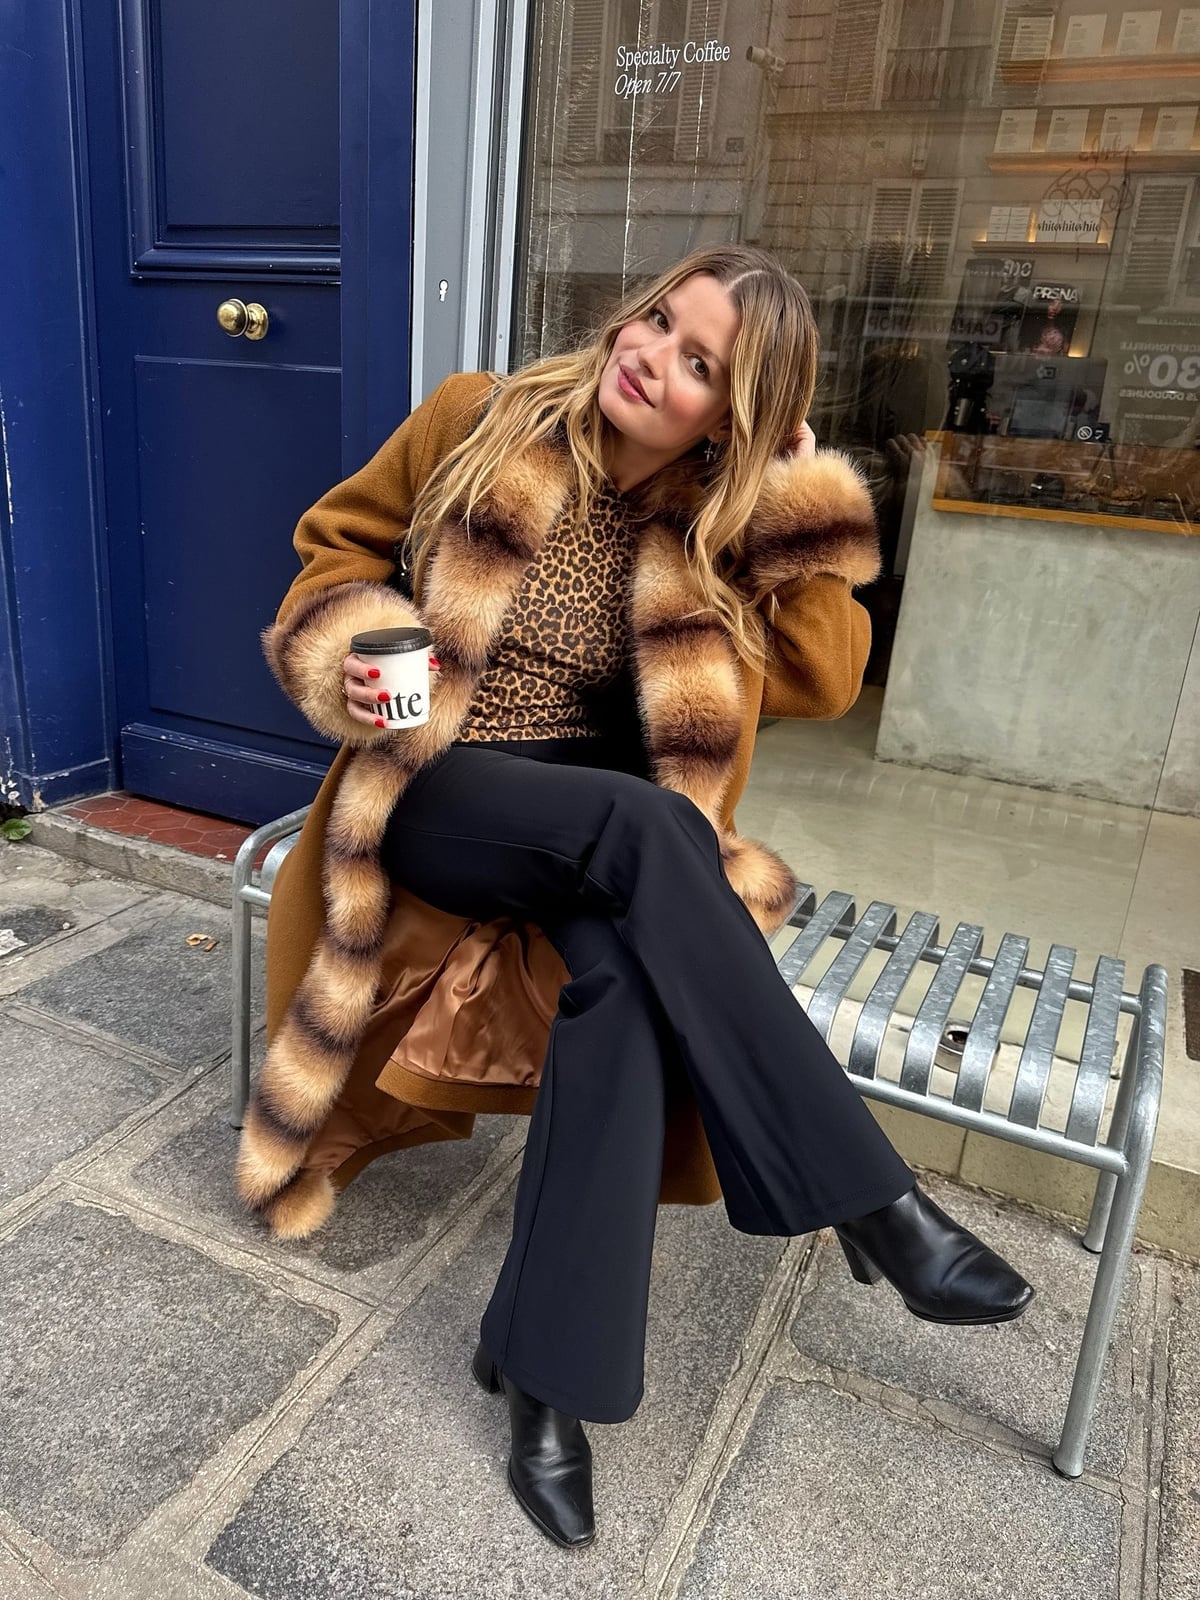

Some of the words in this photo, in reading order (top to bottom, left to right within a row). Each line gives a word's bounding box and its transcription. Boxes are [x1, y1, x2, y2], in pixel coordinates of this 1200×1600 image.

[616, 43, 680, 71] Specialty
[683, 39, 730, 63] Coffee
[614, 73, 652, 99] Open
[654, 71, 682, 93] 7/7
[369, 691, 424, 721] ite
